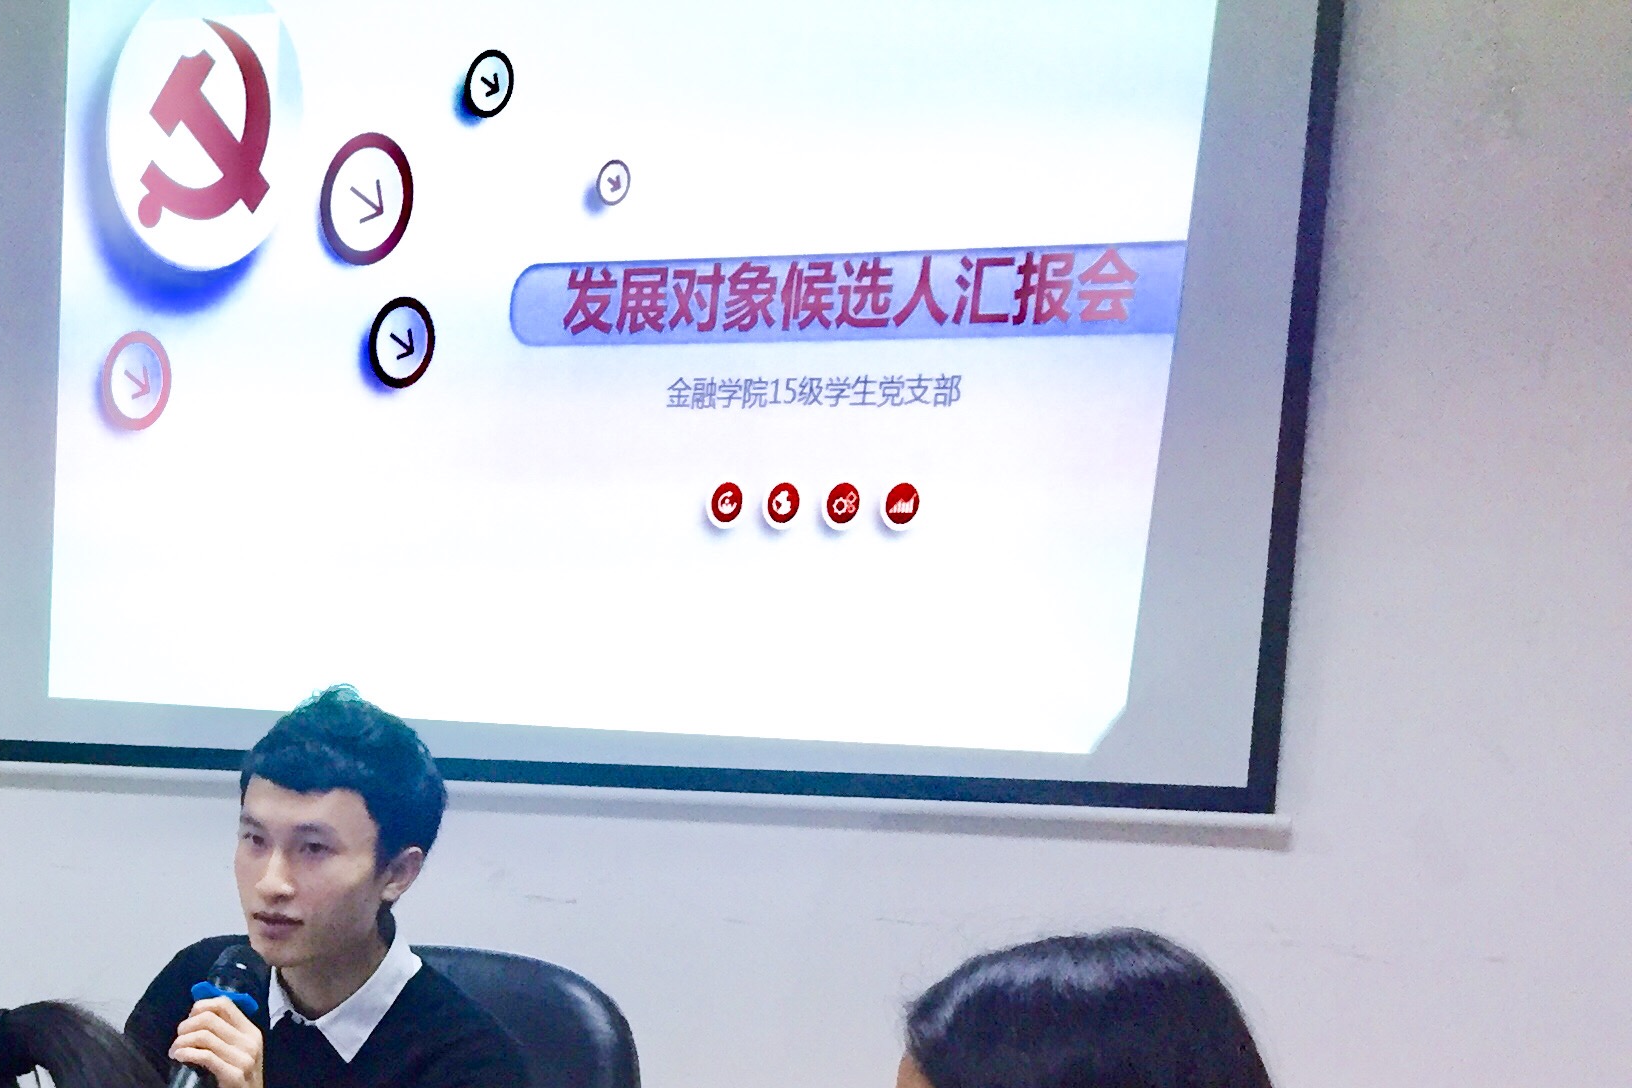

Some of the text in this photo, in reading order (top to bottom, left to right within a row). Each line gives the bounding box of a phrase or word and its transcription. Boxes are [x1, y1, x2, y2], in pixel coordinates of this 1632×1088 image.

[564, 248, 1139, 335] 发展对象候选人汇报会
[666, 373, 962, 410] 金融学院15级学生党支部
